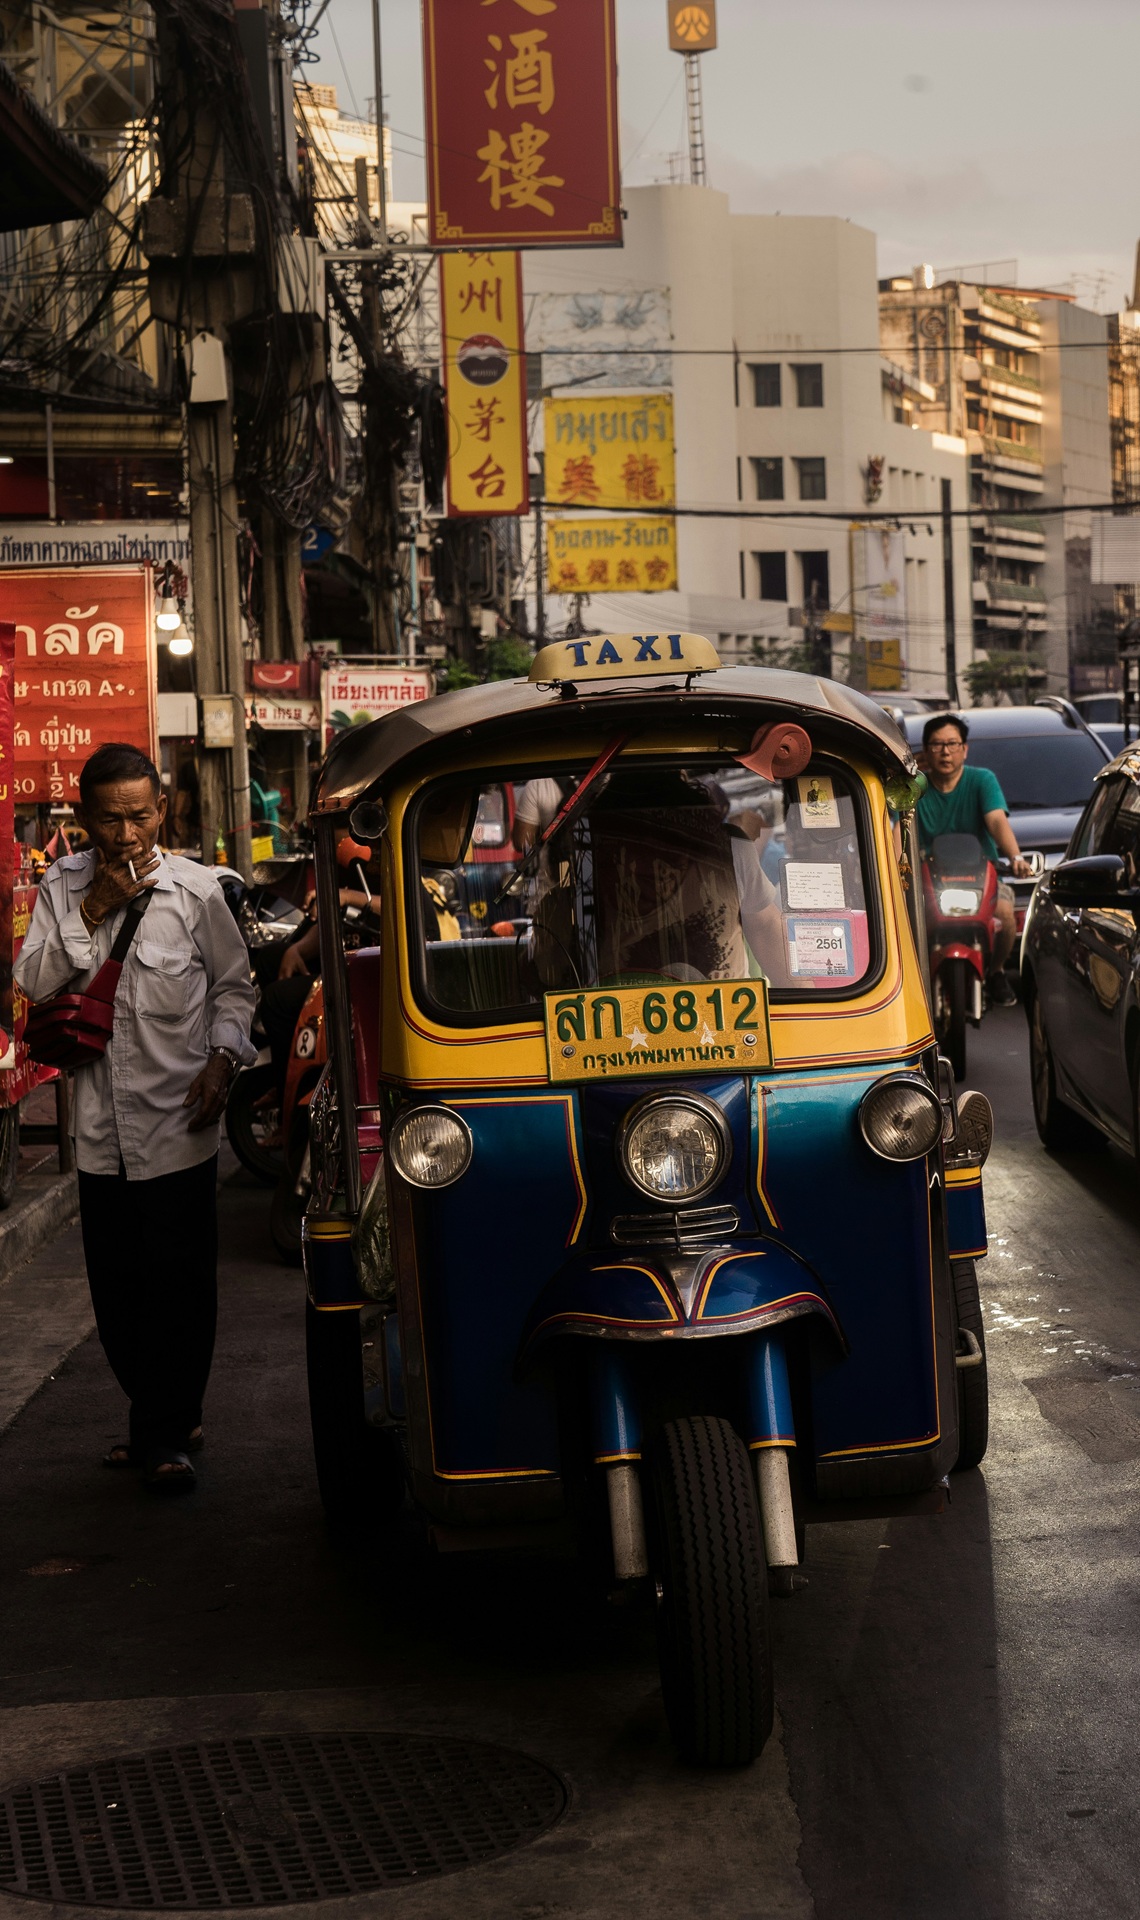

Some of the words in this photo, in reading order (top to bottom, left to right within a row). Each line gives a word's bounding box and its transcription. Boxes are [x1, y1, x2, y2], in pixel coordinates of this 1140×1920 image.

[304, 527, 319, 550] 2
[566, 634, 685, 666] TAXI
[815, 937, 844, 950] 2561
[555, 993, 623, 1042] สก
[641, 986, 761, 1034] 6812
[582, 1044, 737, 1074] กรุงเทพมหานคร
